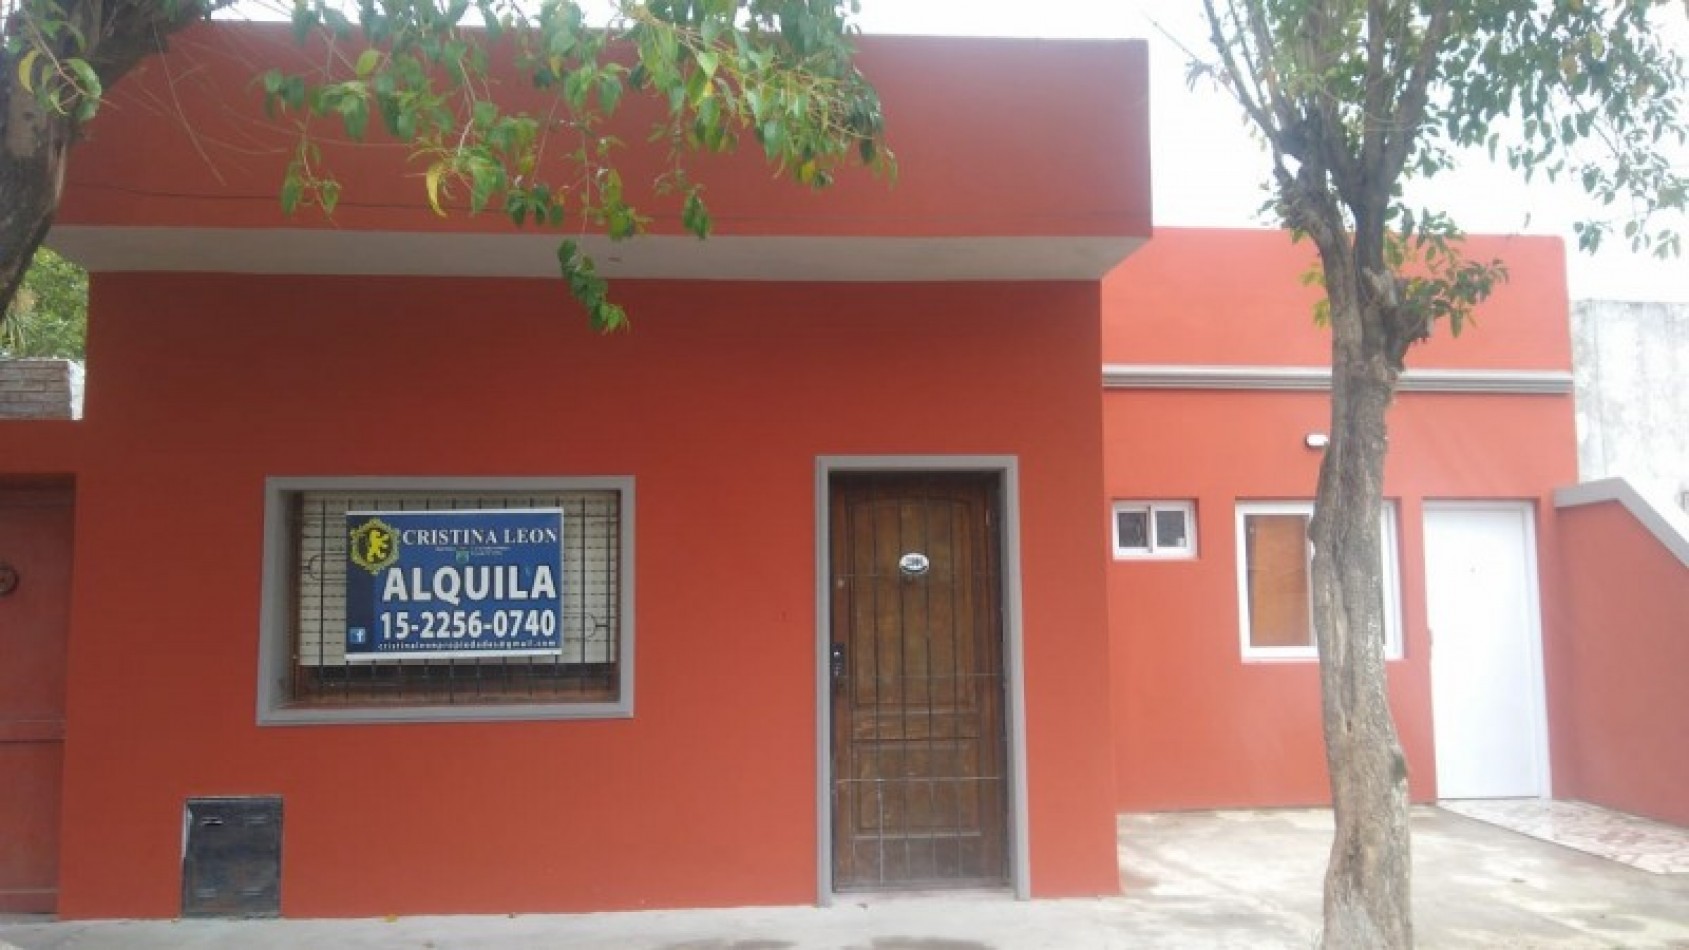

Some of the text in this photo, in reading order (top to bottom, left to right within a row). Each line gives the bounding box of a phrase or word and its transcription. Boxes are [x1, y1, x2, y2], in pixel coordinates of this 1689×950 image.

[402, 528, 557, 546] CRISTINA LEON
[382, 565, 557, 606] ALQUILA
[381, 609, 555, 639] 15-2256-0740
